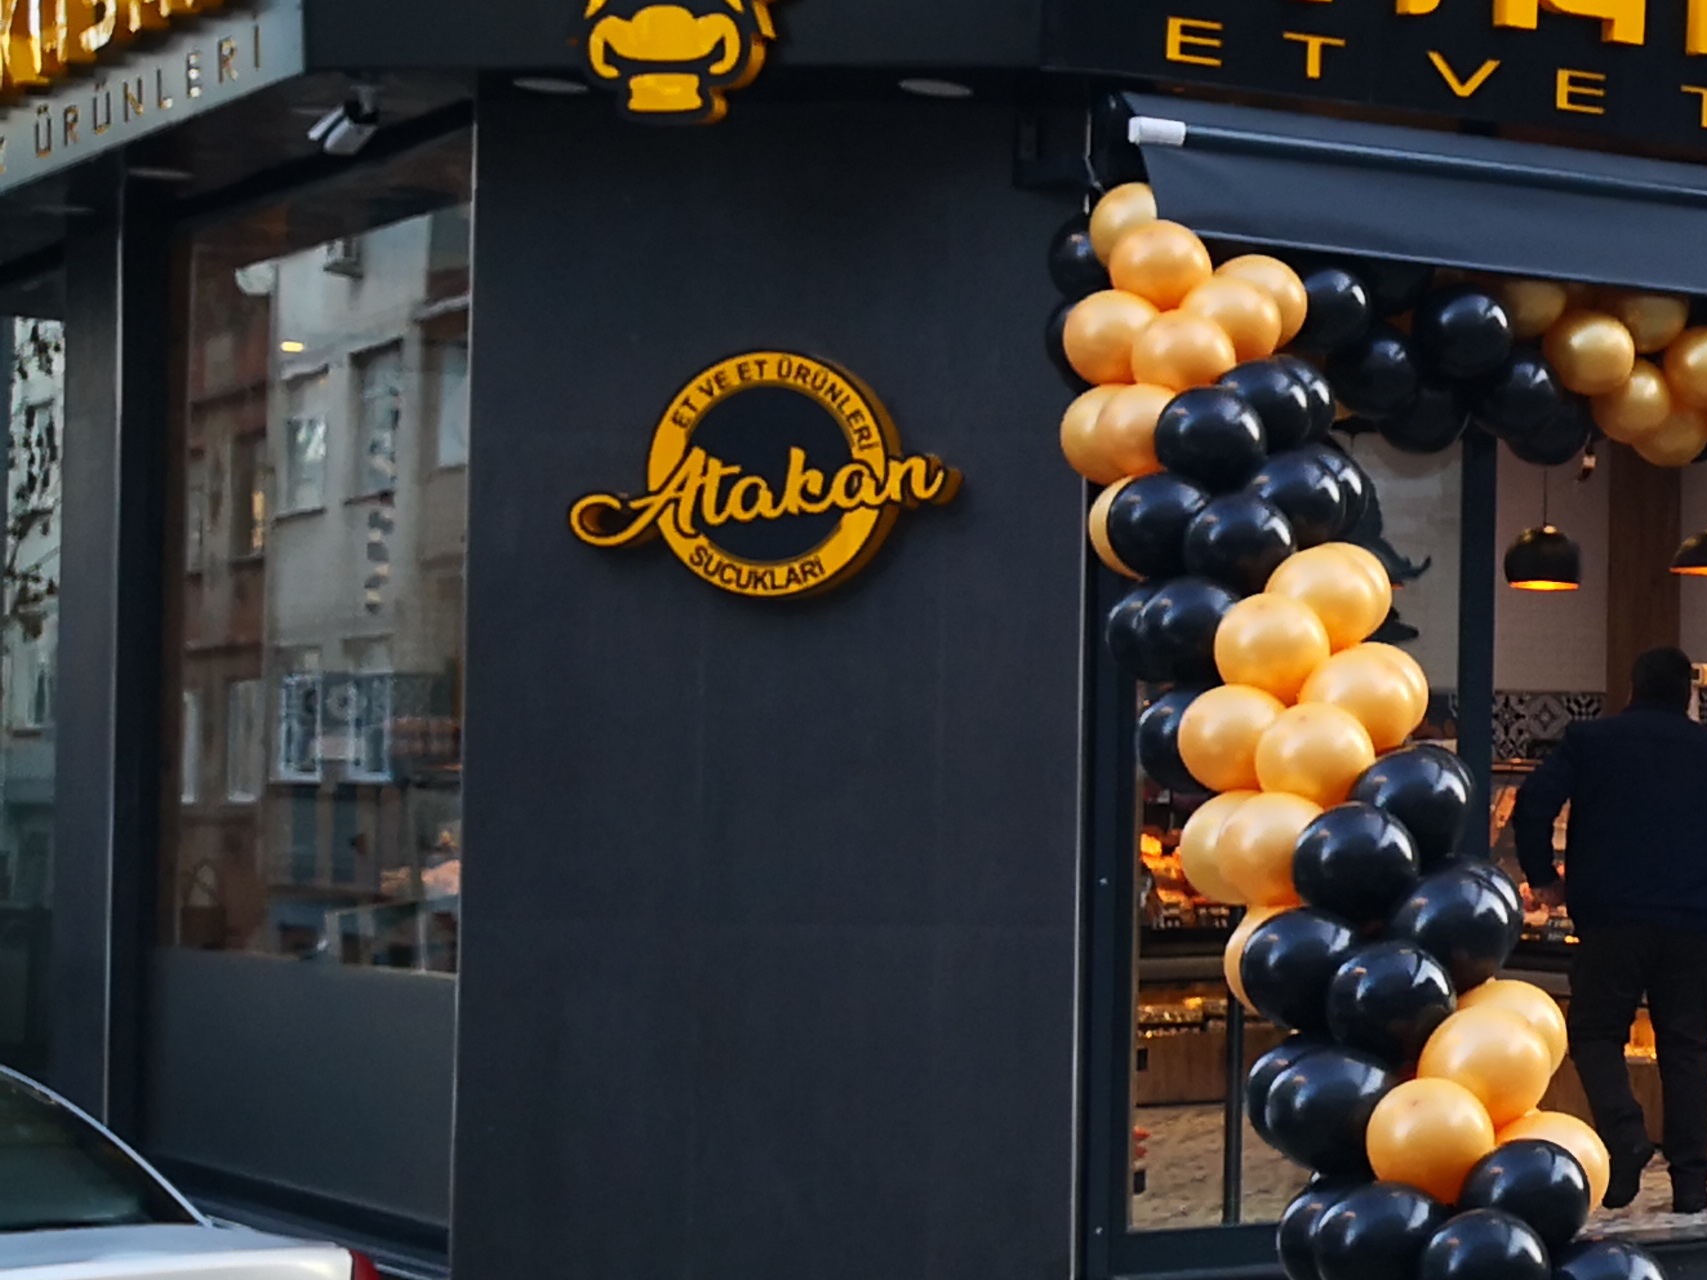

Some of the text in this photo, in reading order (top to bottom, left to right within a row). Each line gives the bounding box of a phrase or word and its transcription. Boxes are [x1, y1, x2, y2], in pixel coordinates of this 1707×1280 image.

[35, 14, 261, 157] ÜRÜNLERİ
[1166, 17, 1346, 79] ET
[1428, 51, 1605, 115] VE
[671, 398, 698, 429] ET
[698, 371, 728, 398] VE
[738, 358, 769, 381] ET
[570, 446, 945, 548] Atakan
